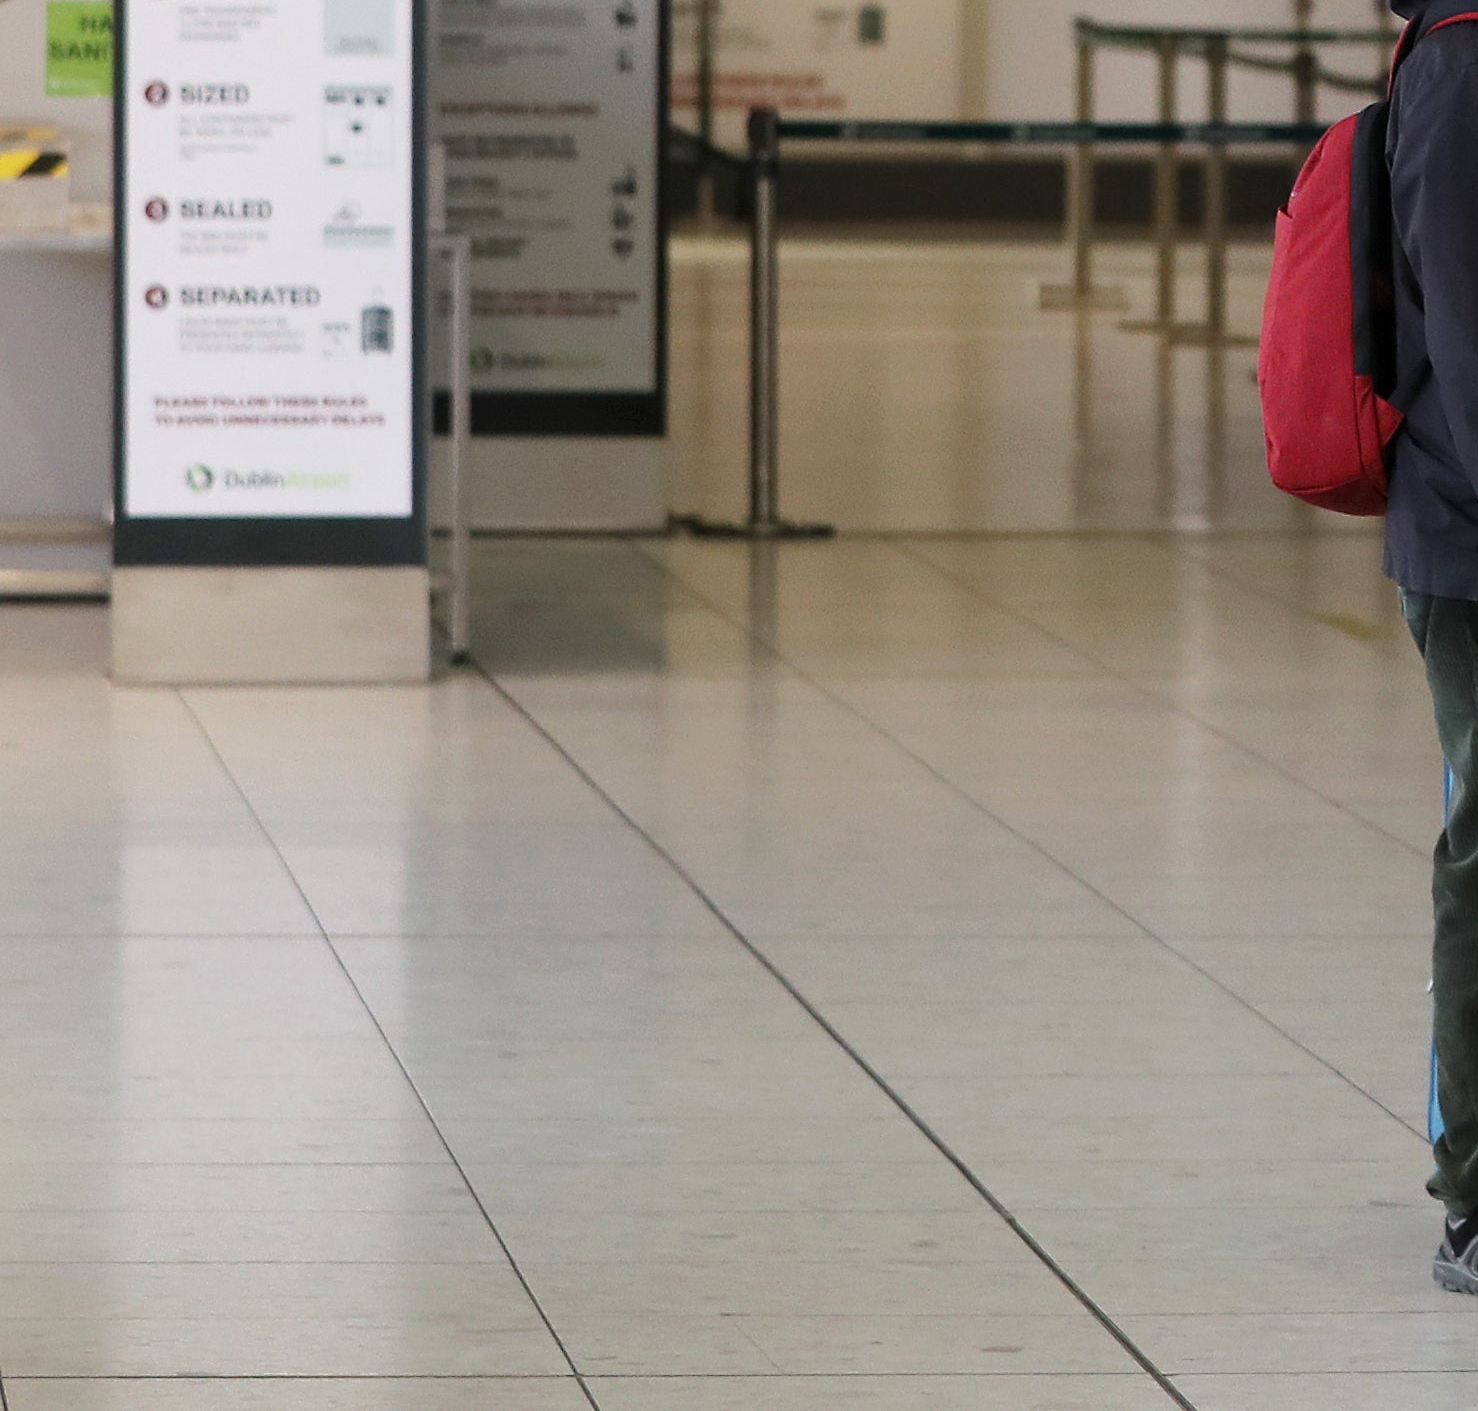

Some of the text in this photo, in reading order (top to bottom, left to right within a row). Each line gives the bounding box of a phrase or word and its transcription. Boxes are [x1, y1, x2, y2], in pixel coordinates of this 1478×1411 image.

[178, 81, 251, 106] SIZED
[178, 197, 274, 222] SEALED
[179, 284, 322, 308] SEPARATED
